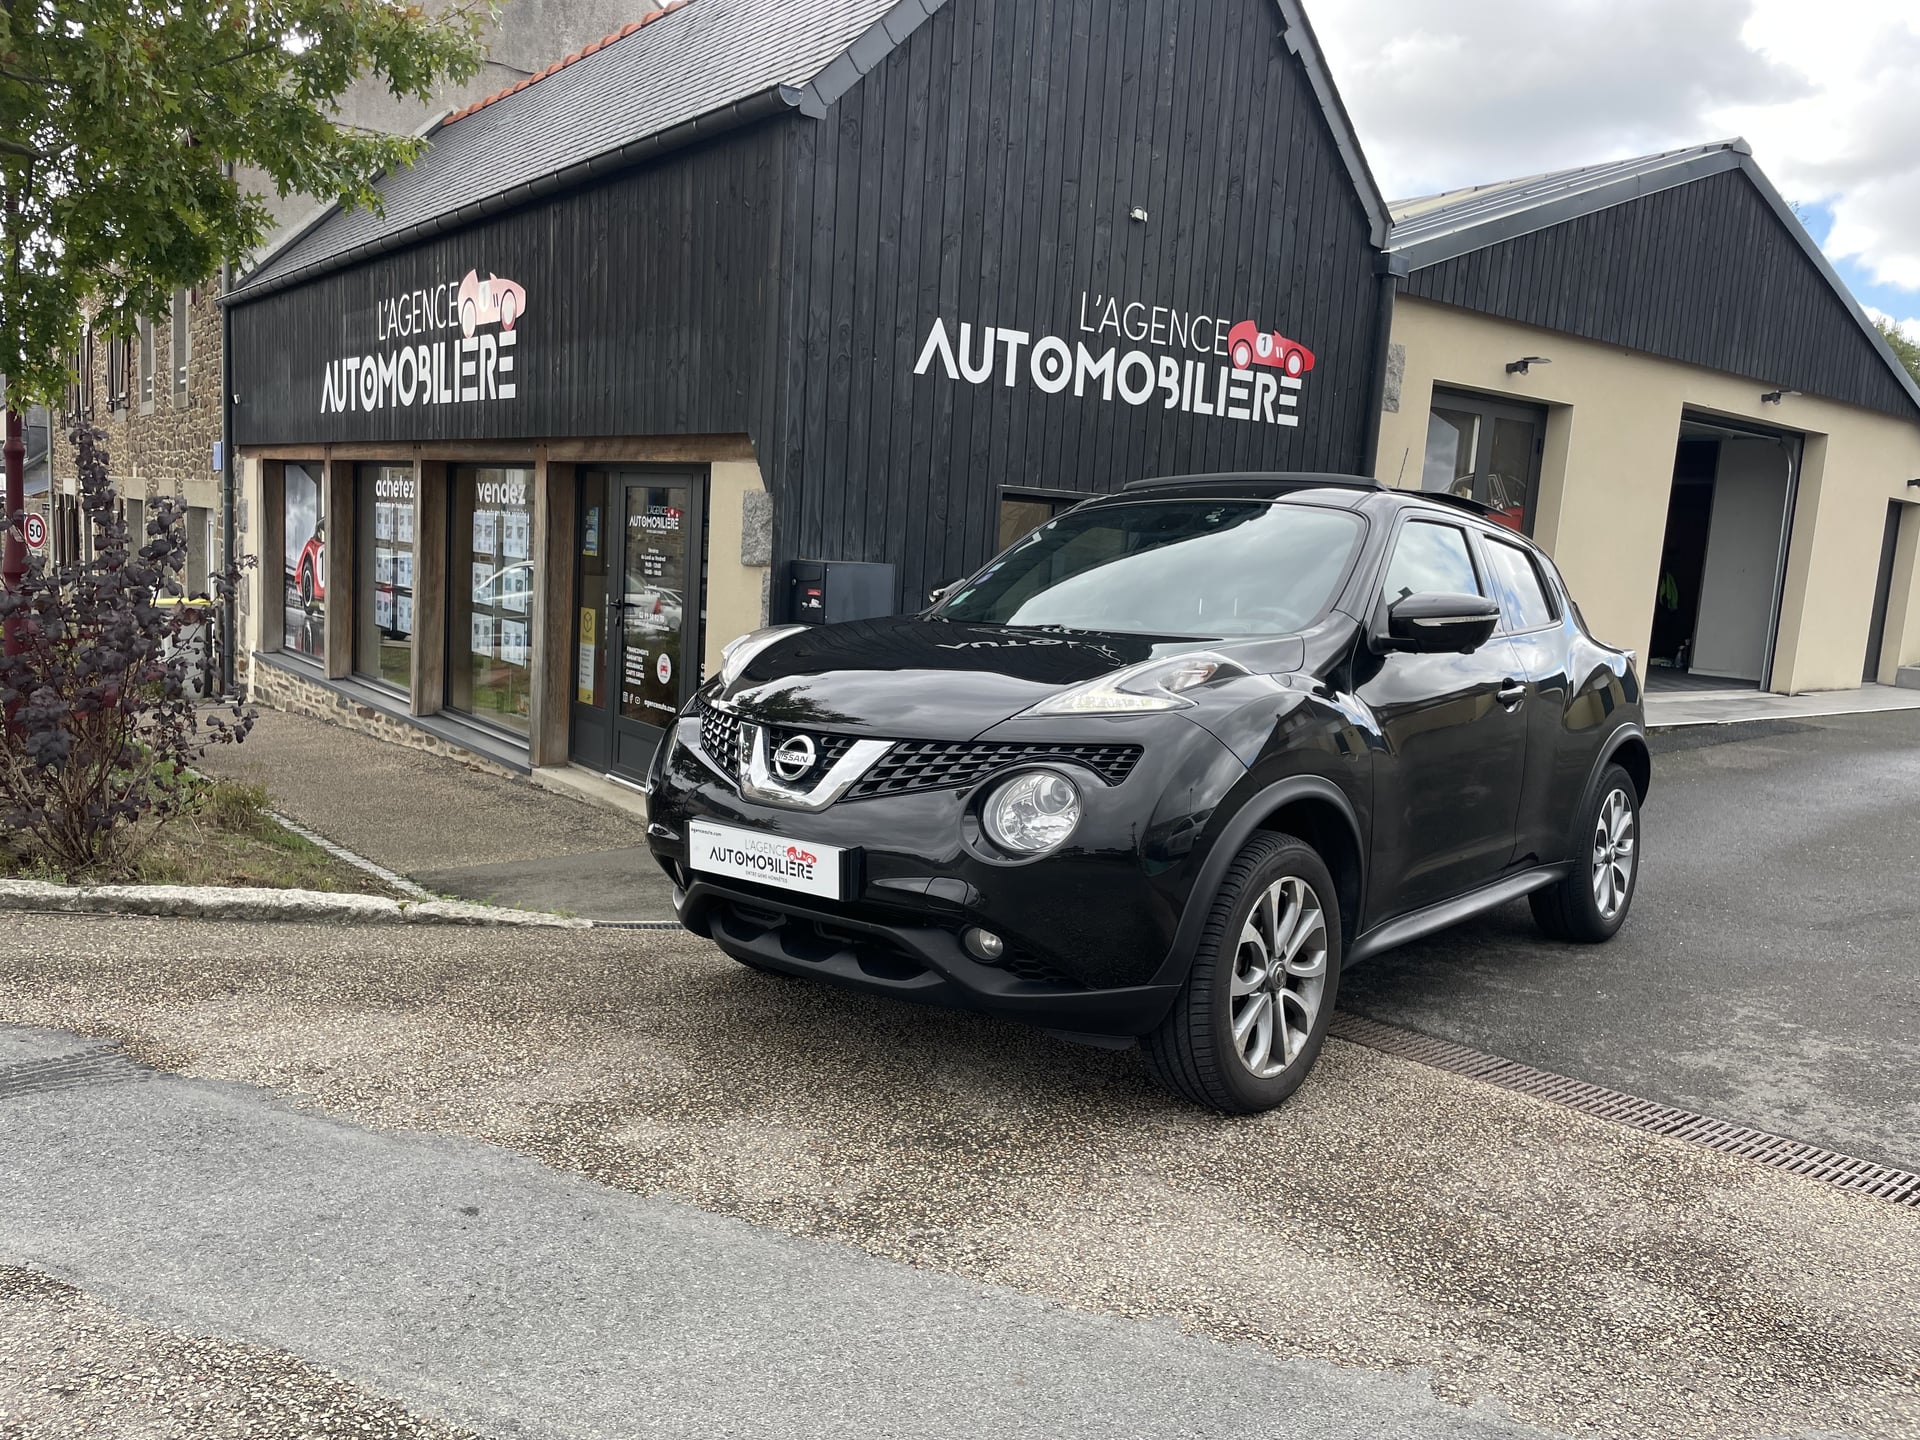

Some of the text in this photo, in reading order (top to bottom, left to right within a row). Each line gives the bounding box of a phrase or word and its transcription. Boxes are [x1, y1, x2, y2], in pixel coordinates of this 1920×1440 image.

[378, 282, 459, 341] L'AGENCE
[1080, 291, 1232, 356] L'AGENCE
[1261, 335, 1268, 352] 1
[375, 470, 414, 498] achetez
[477, 475, 526, 505] vendez
[29, 524, 42, 538] 50
[776, 750, 809, 763] NISSAN
[744, 839, 788, 857] L'AGENCE
